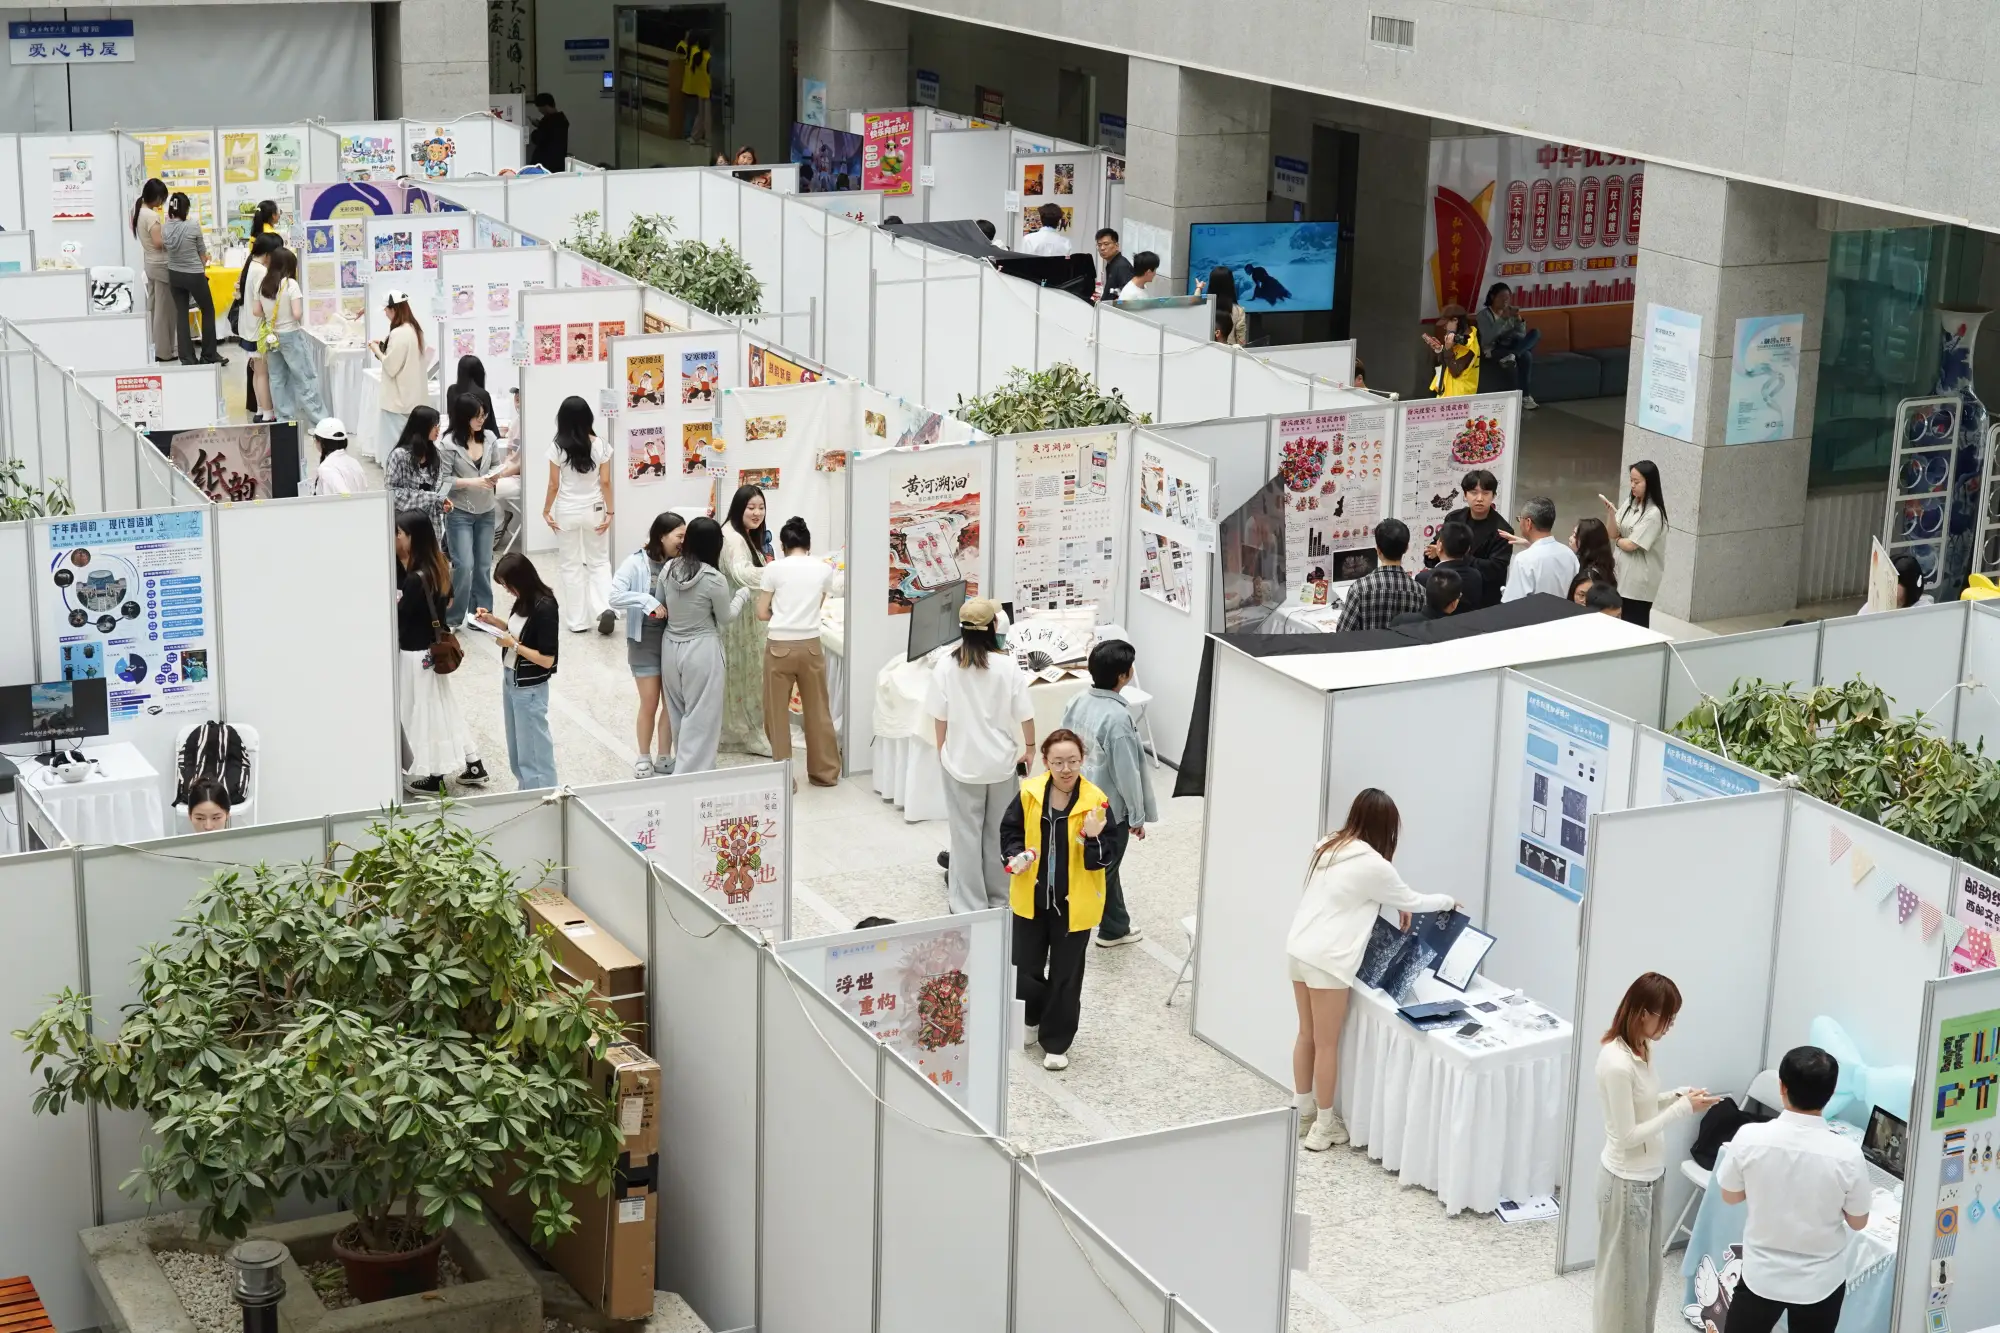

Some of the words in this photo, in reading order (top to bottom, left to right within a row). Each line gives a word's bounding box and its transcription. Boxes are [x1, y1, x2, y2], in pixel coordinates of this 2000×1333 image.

[29, 42, 118, 58] 爱心书屋
[1511, 196, 1522, 239] 天下为公
[1535, 194, 1547, 237] 民为邦本
[1559, 193, 1570, 236] 为政以德
[1583, 191, 1595, 234] 革故鼎新
[1607, 190, 1619, 233] 任人唯贤
[1631, 189, 1642, 228] 天人合一
[629, 355, 662, 365] 安塞腰鼓
[685, 350, 716, 361] 安塞腰鼓
[630, 426, 663, 436] 安塞腰鼓
[901, 475, 967, 497] 黄河溯洄
[727, 892, 750, 905] WEN
[836, 972, 874, 995] 浮世
[858, 992, 897, 1017] 重构
